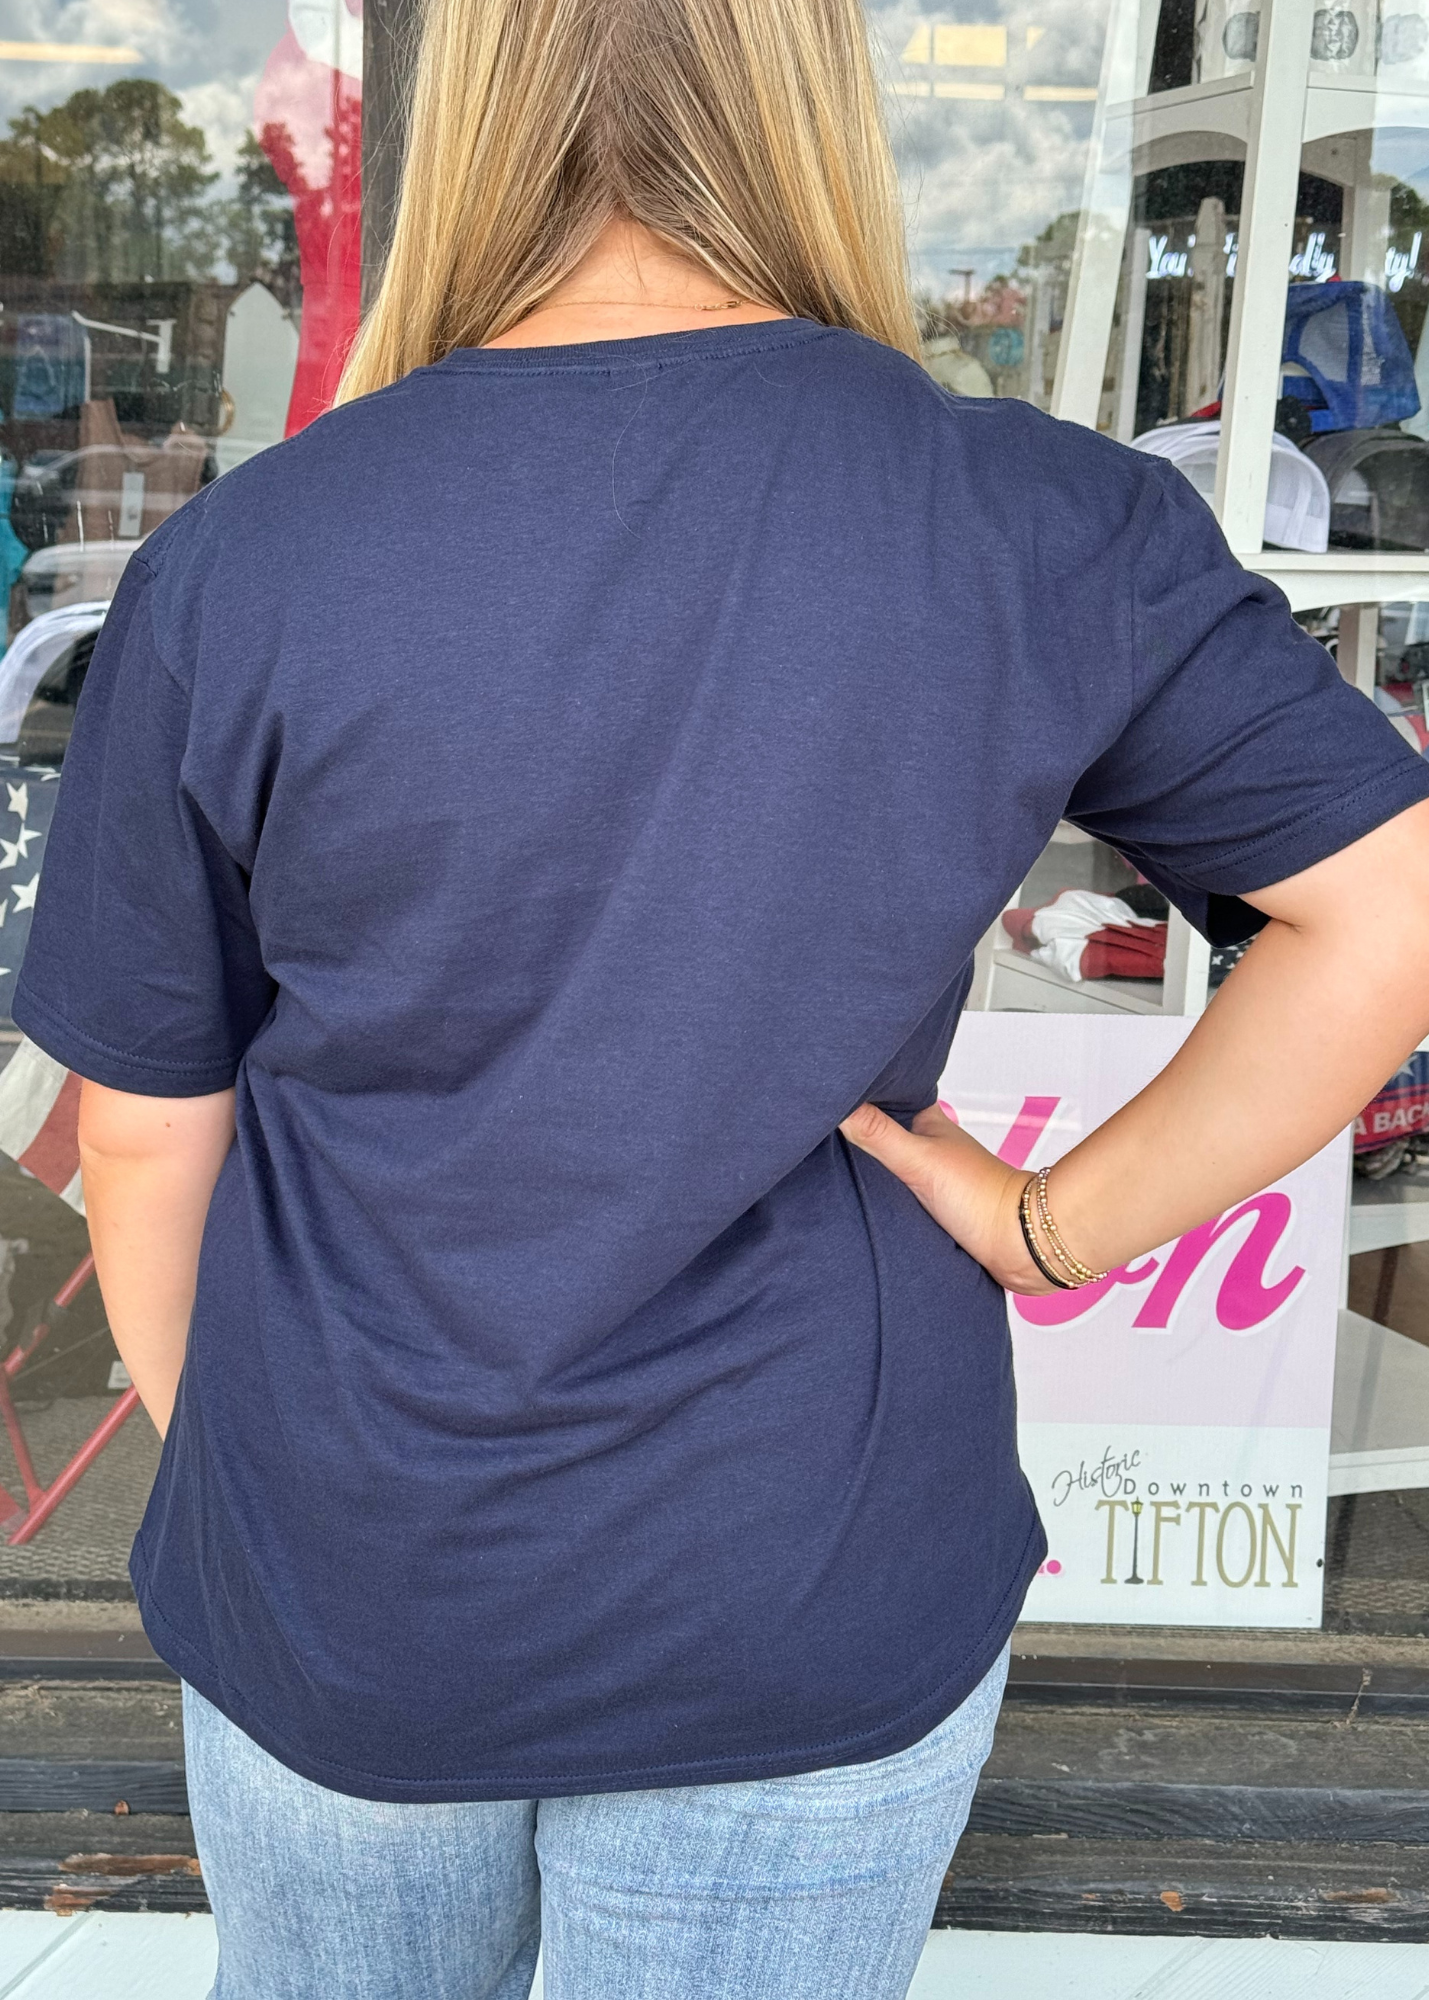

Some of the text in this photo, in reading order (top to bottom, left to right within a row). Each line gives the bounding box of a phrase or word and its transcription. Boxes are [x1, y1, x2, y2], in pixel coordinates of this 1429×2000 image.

[1051, 1445, 1142, 1507] Historic
[1123, 1478, 1304, 1499] Downtown
[1094, 1497, 1303, 1589] TIFTON
